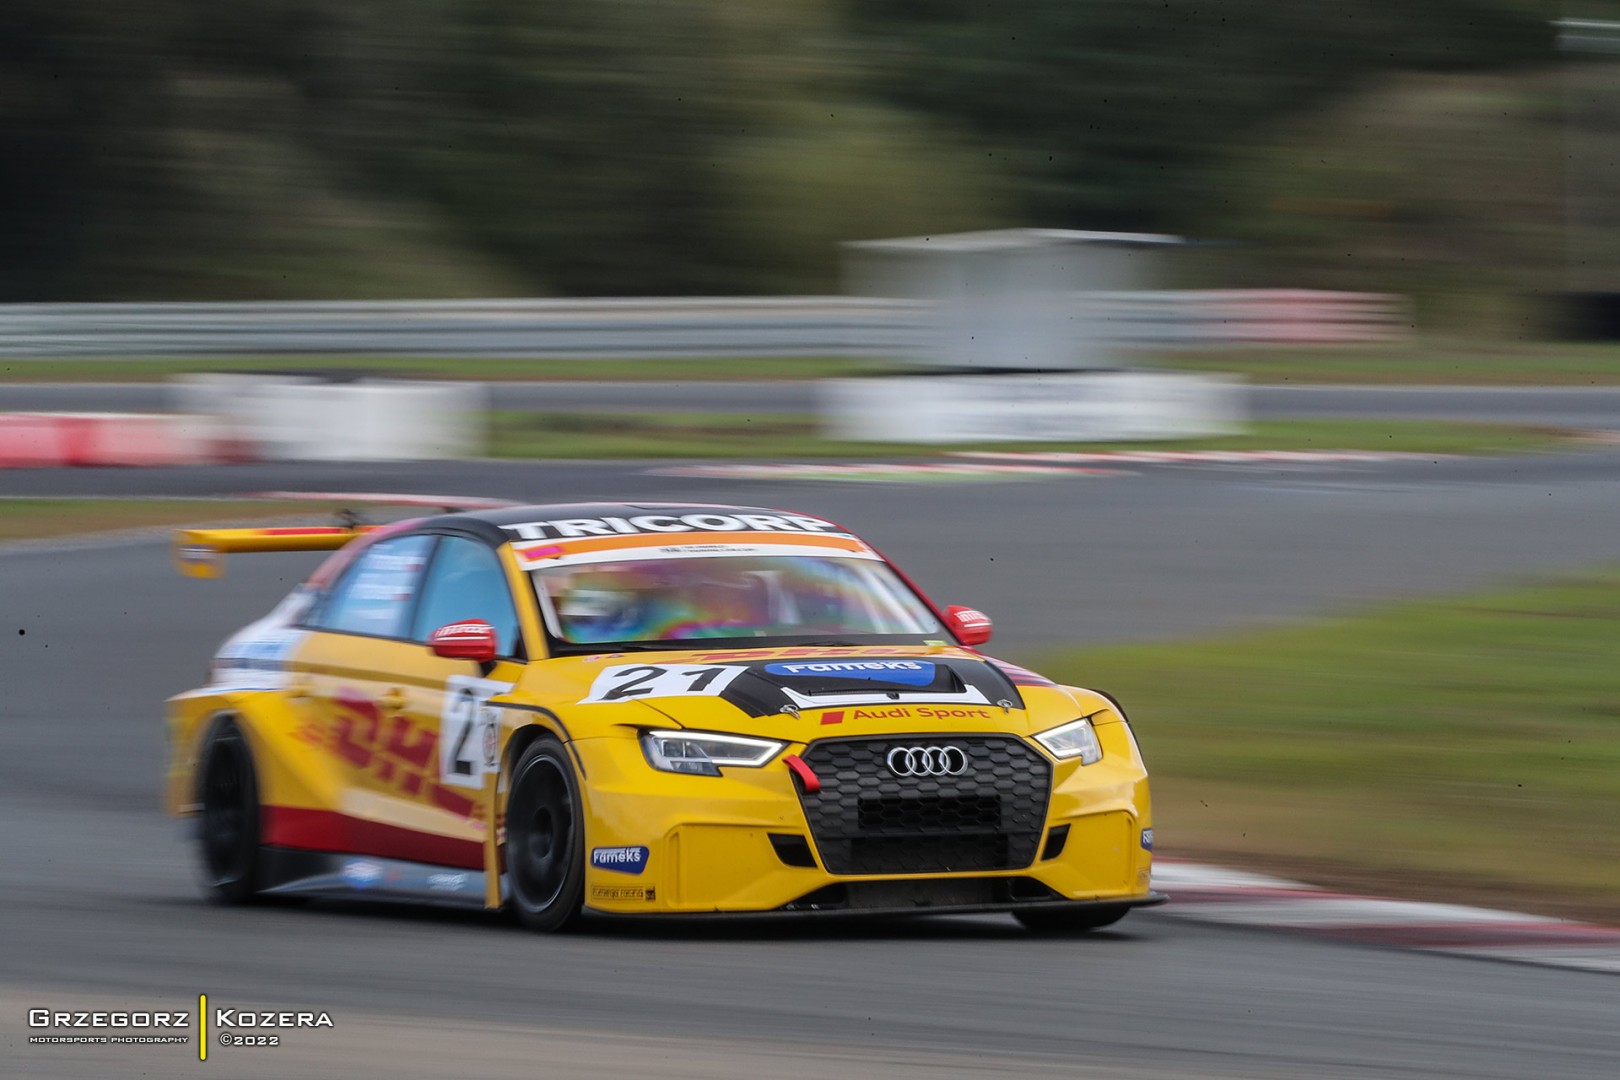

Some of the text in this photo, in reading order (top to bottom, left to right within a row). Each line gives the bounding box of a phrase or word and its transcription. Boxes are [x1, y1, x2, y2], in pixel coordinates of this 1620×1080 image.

[498, 514, 837, 541] TRICORP
[783, 661, 922, 673] Fameks
[596, 666, 727, 701] 21
[853, 708, 991, 720] Audi Sport
[593, 848, 642, 864] Fameks
